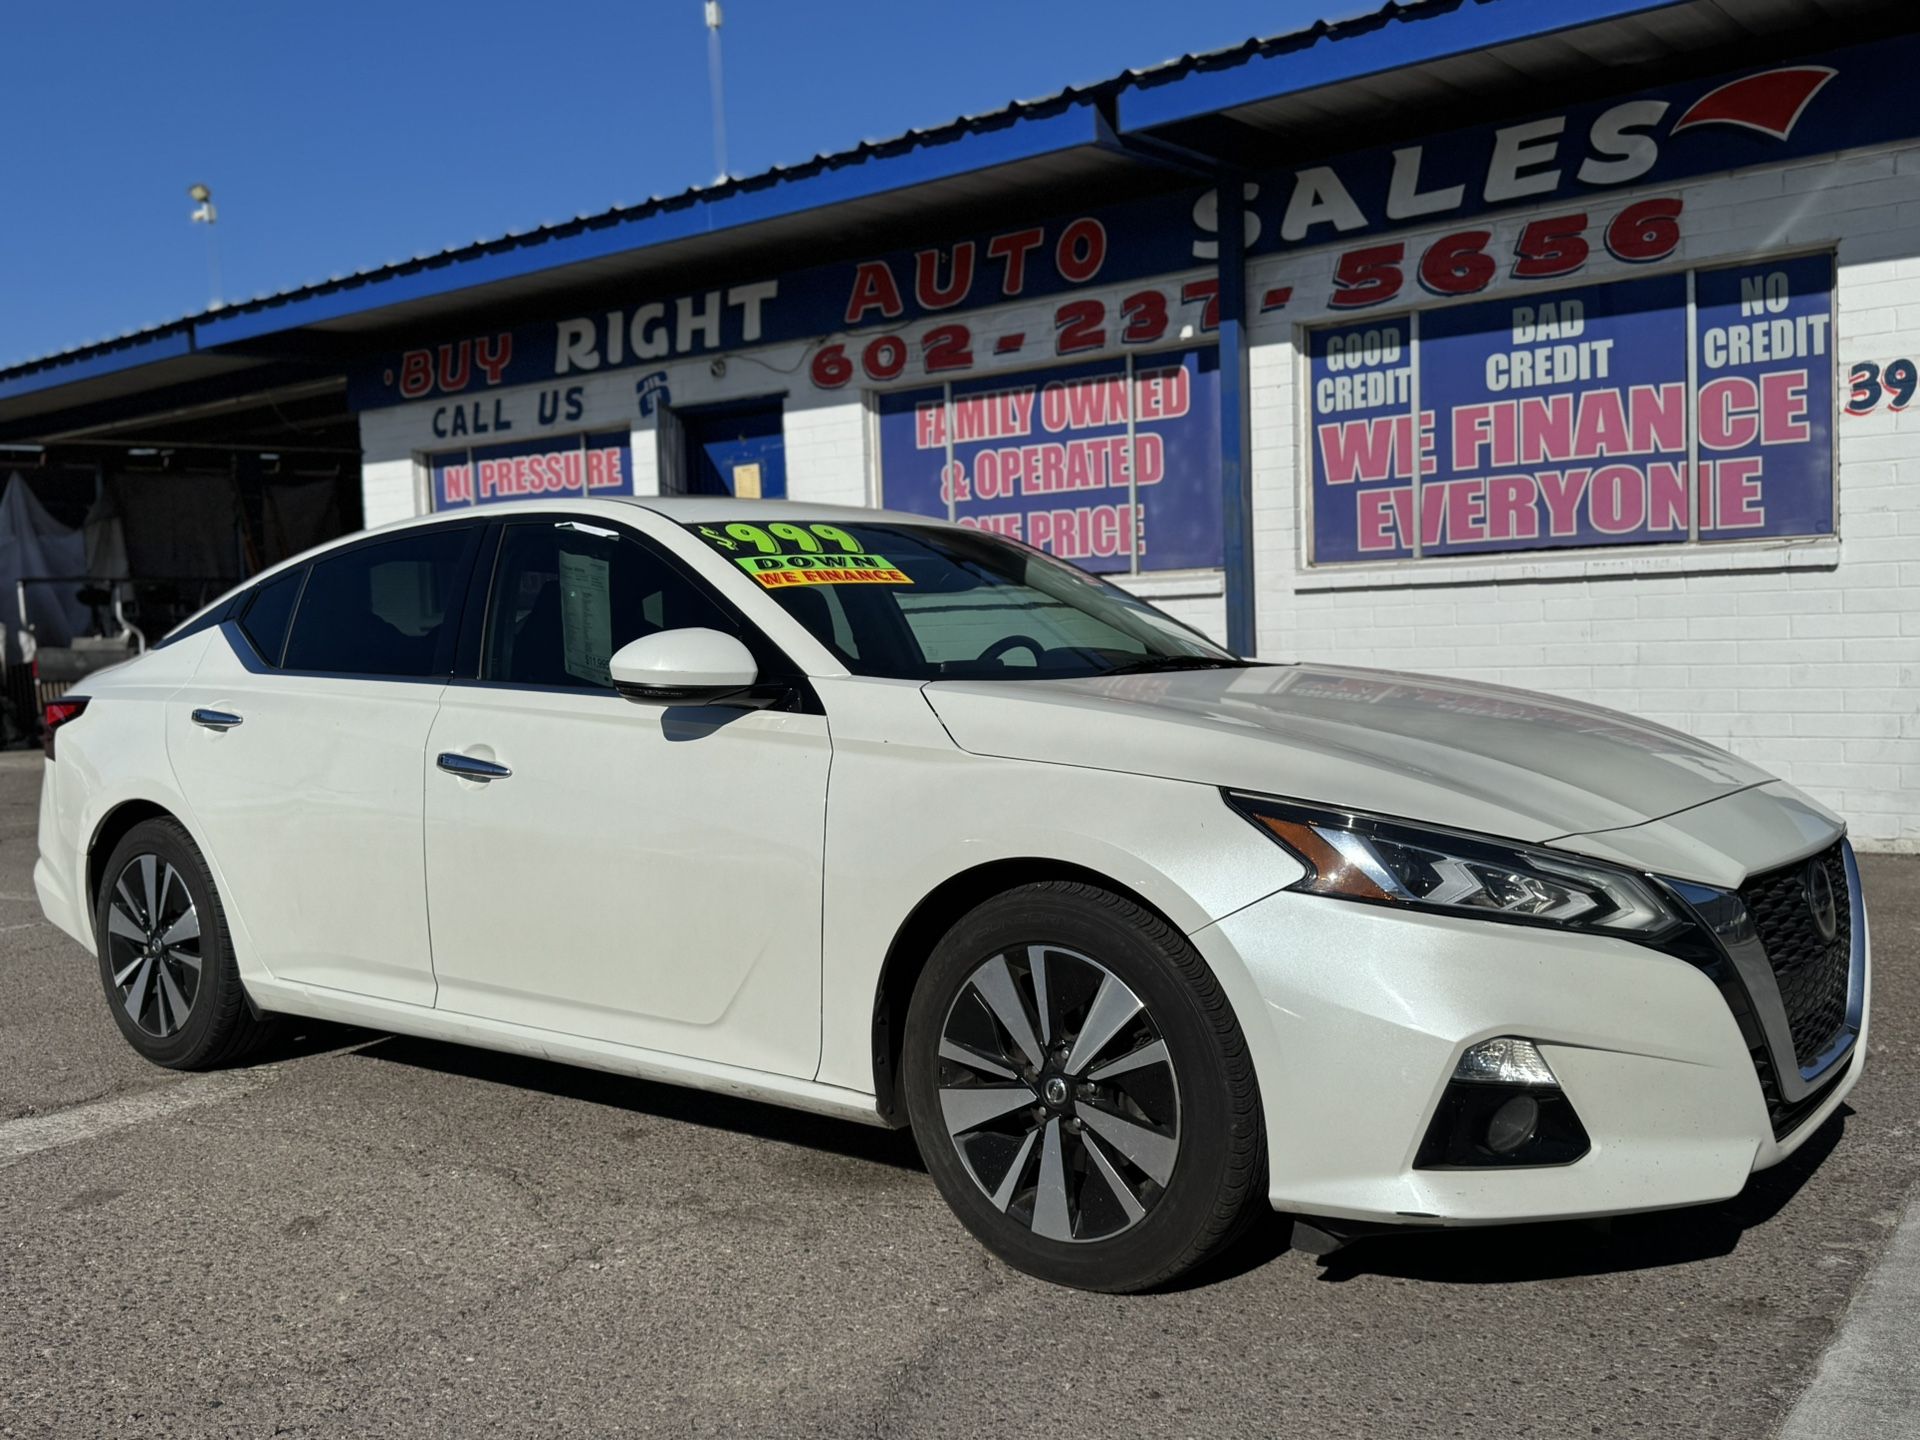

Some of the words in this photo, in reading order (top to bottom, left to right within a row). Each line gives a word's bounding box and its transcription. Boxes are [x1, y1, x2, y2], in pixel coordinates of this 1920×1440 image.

[400, 333, 512, 398] BUY
[555, 282, 777, 373] RIGHT
[844, 217, 1107, 324] AUTO
[1193, 100, 1671, 259] SALES
[1740, 271, 1789, 317] NO
[1512, 300, 1585, 345] BAD
[1704, 313, 1829, 369] CREDIT
[1326, 327, 1400, 373] GOOD
[1485, 339, 1613, 391] CREDIT
[432, 398, 512, 438] CALL
[538, 386, 584, 426] US
[916, 384, 1036, 449] FAMILY
[1041, 365, 1190, 433] OWNED
[1317, 366, 1411, 415] CREDIT
[1844, 358, 1918, 416] 39
[1318, 410, 1436, 487] WE
[1452, 369, 1810, 473] FINANCE
[479, 447, 622, 497] PRESSURE
[940, 460, 971, 504] &
[974, 432, 1164, 499] OPERATED
[1357, 456, 1765, 552] EVERYONE
[698, 523, 864, 554] $999
[1028, 504, 1146, 558] PRICE
[754, 556, 880, 569] DOWN
[757, 570, 798, 584] WE
[805, 569, 905, 582] FINANCE
